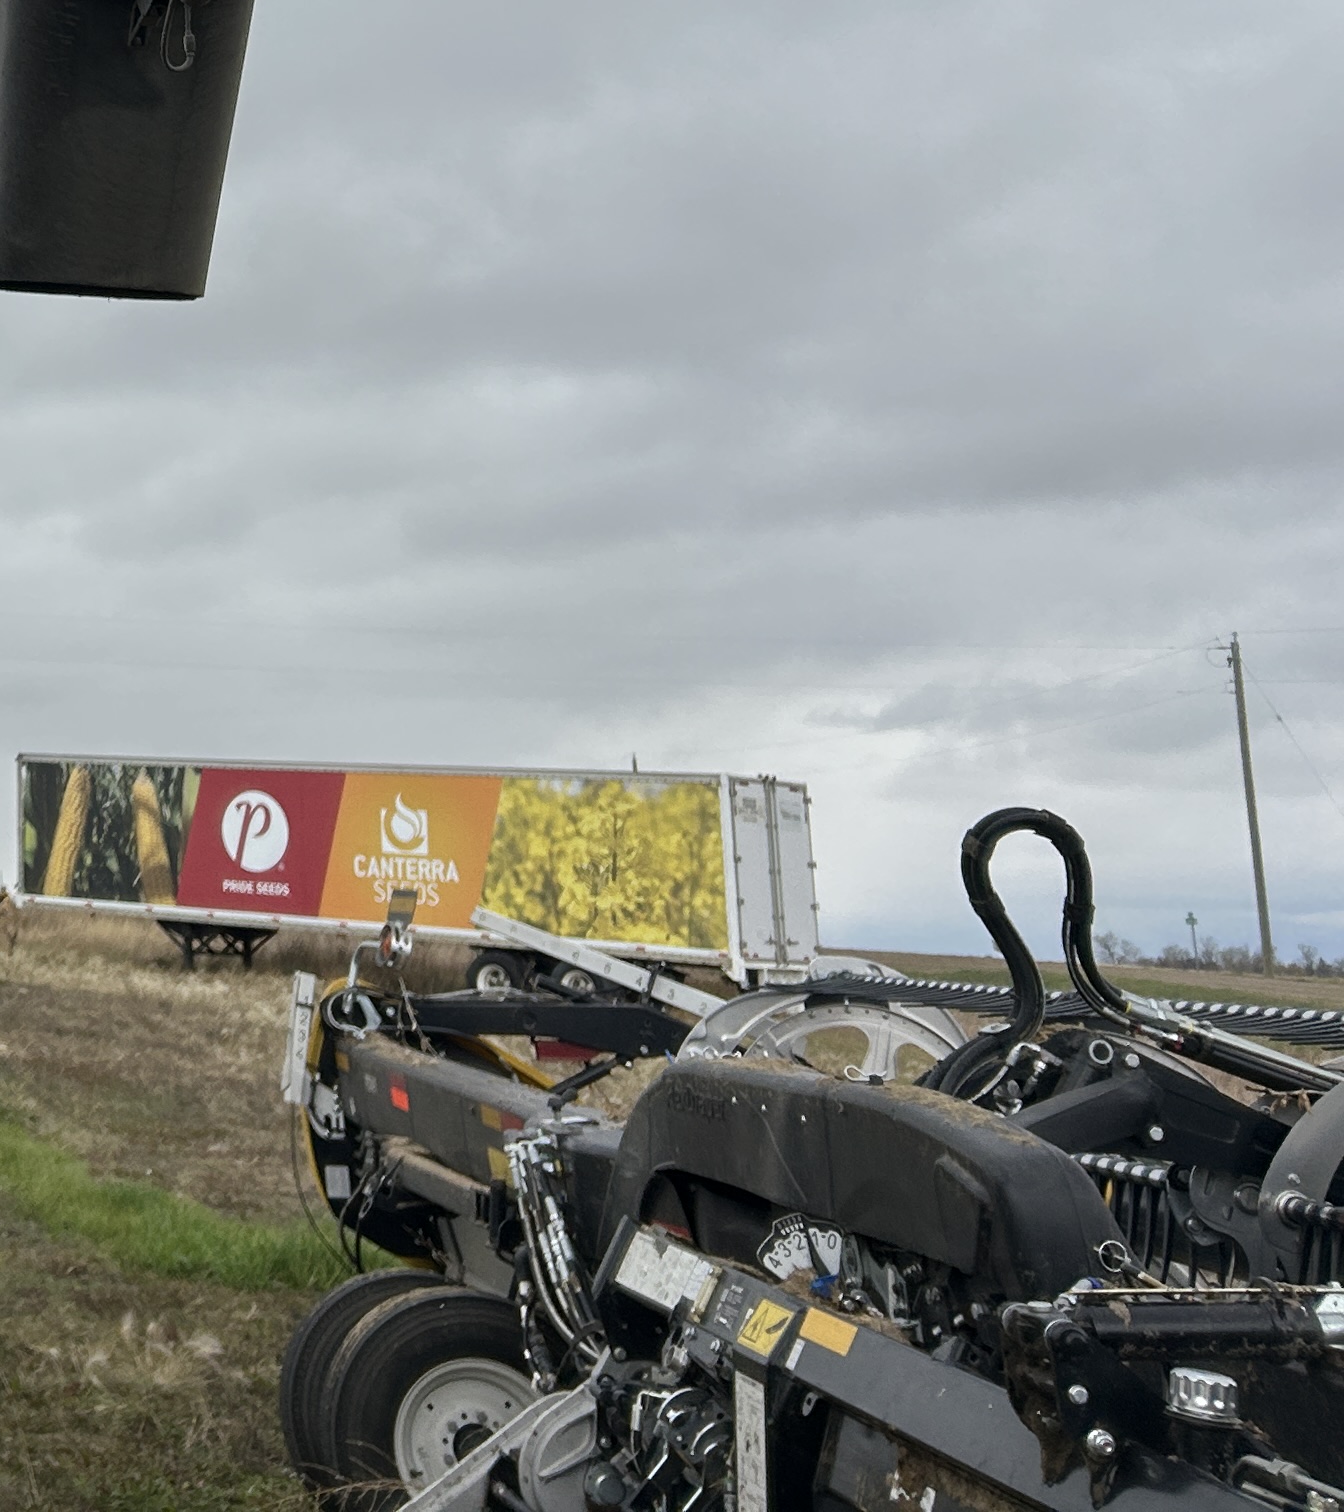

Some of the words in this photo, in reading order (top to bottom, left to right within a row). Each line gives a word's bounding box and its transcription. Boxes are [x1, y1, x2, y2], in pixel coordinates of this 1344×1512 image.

[353, 854, 460, 883] CANTERRA
[222, 879, 254, 894] PRIDE
[255, 881, 290, 896] SEEDS
[778, 1242, 792, 1257] 3
[793, 1234, 805, 1250] 2
[827, 1233, 838, 1250] 0
